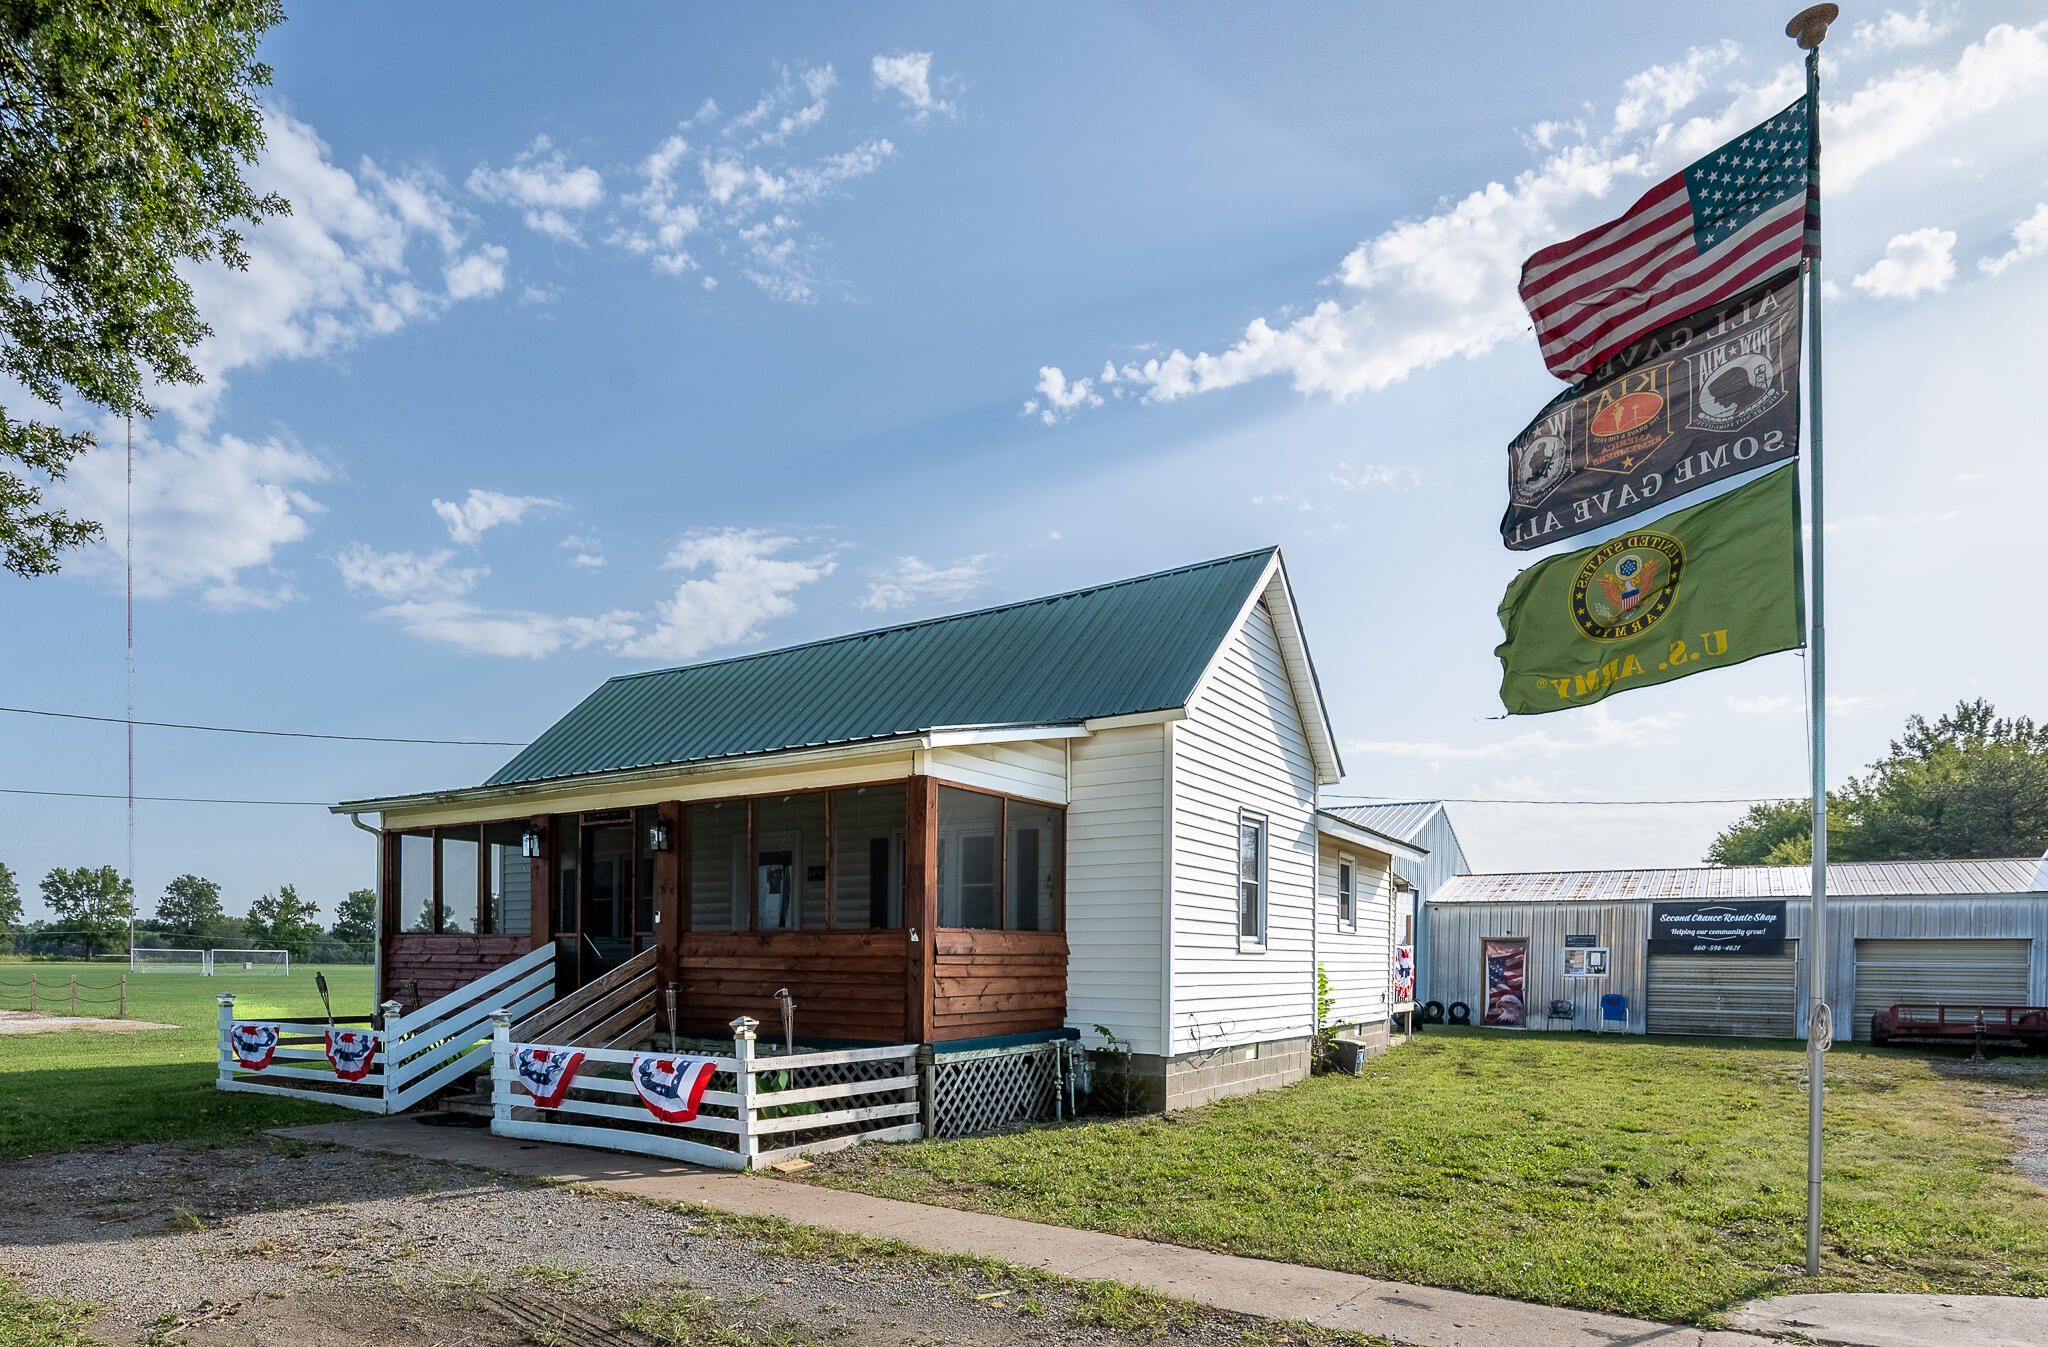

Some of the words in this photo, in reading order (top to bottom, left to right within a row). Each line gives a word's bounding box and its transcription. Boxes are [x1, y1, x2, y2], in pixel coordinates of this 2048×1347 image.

[1660, 913, 1691, 922] Second
[1691, 913, 1722, 922] Chance
[1722, 913, 1753, 922] Resale
[1753, 913, 1777, 923] Shop
[1670, 928, 1695, 937] Helping
[1708, 928, 1745, 937] community
[1745, 928, 1767, 937] grow!
